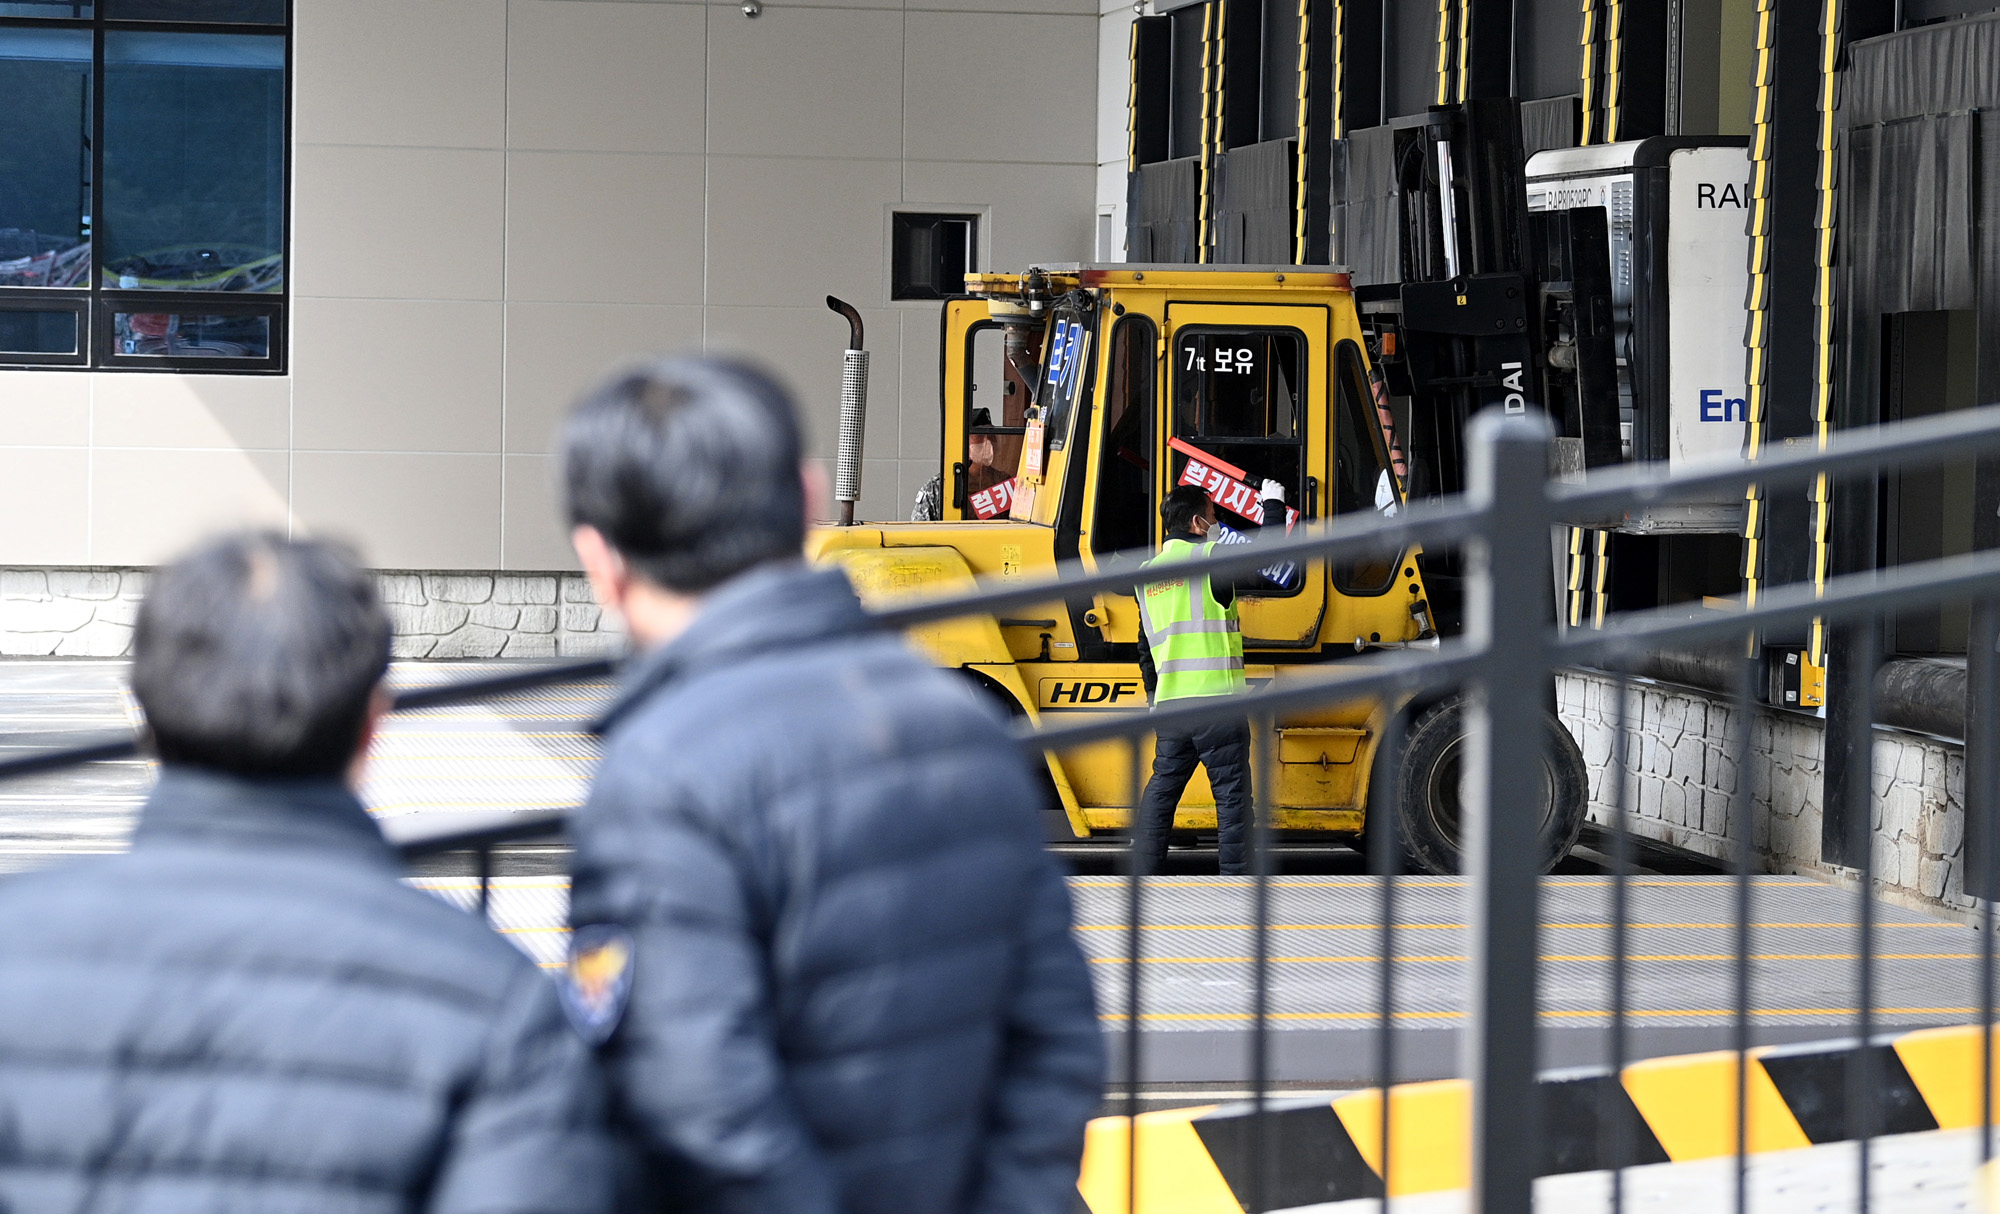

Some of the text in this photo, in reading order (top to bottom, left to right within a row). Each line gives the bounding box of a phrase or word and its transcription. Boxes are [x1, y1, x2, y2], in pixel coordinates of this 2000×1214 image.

[1214, 348, 1254, 375] 보유
[1501, 361, 1526, 421] DAI
[971, 477, 1018, 516] 럭키
[1050, 682, 1138, 703] HDF
